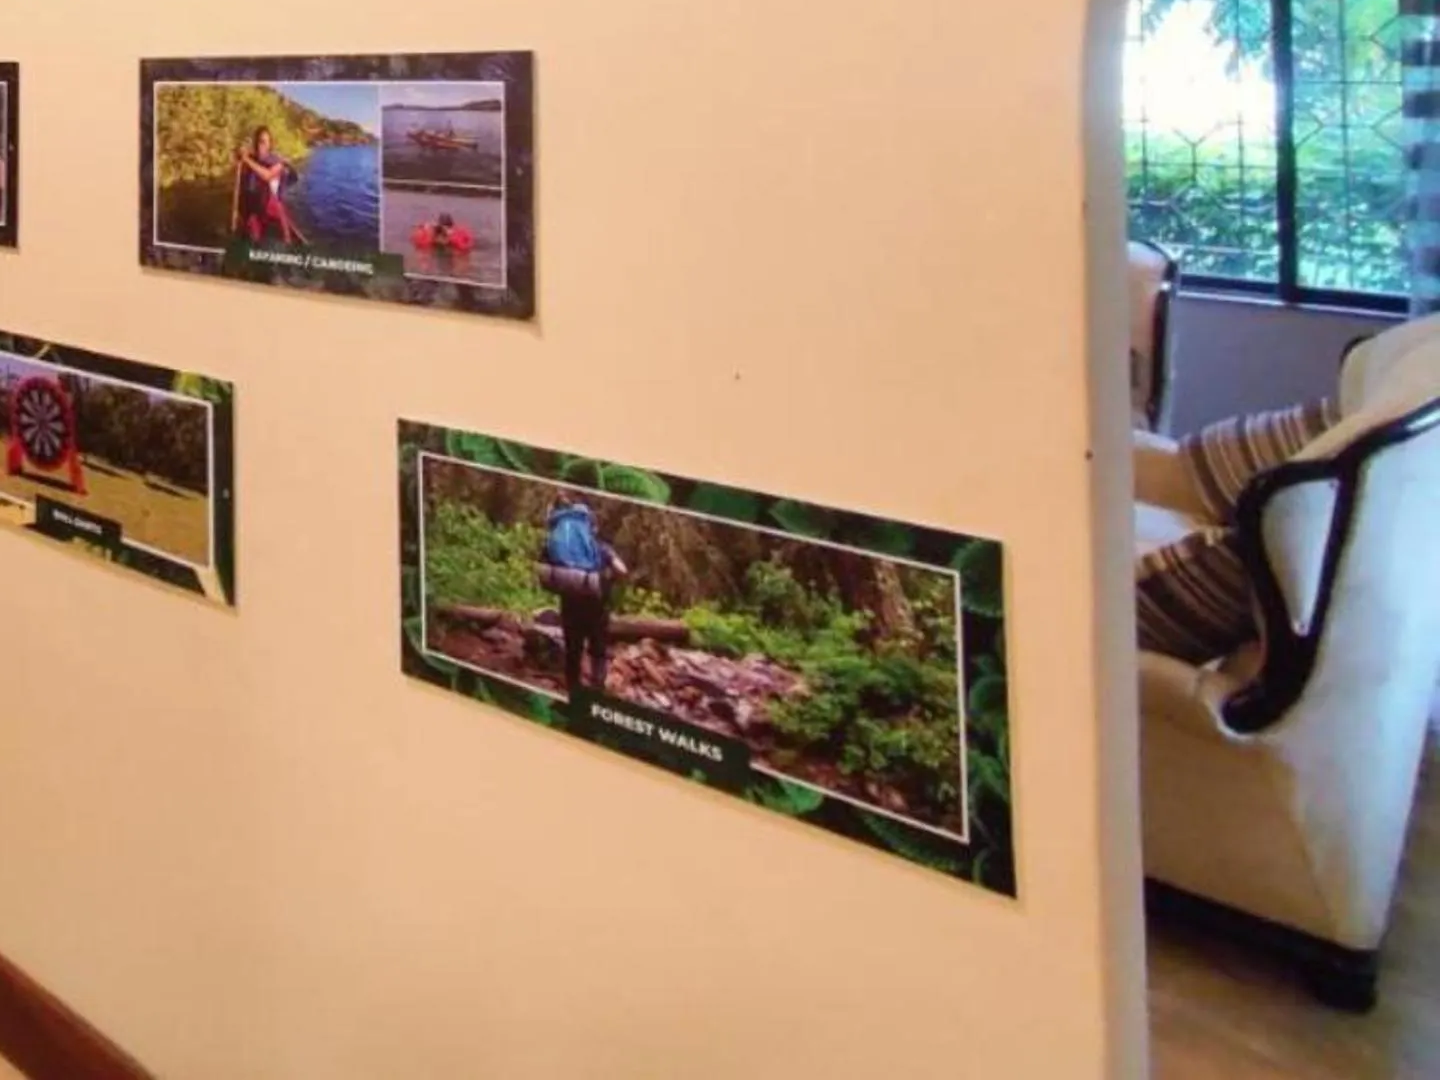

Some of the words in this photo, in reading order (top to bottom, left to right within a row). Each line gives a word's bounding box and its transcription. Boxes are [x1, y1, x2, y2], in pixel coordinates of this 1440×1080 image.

[249, 249, 303, 266] KAYAKING
[312, 255, 374, 275] CANOEING
[590, 703, 655, 736] FOREST
[658, 726, 723, 762] WALKS
